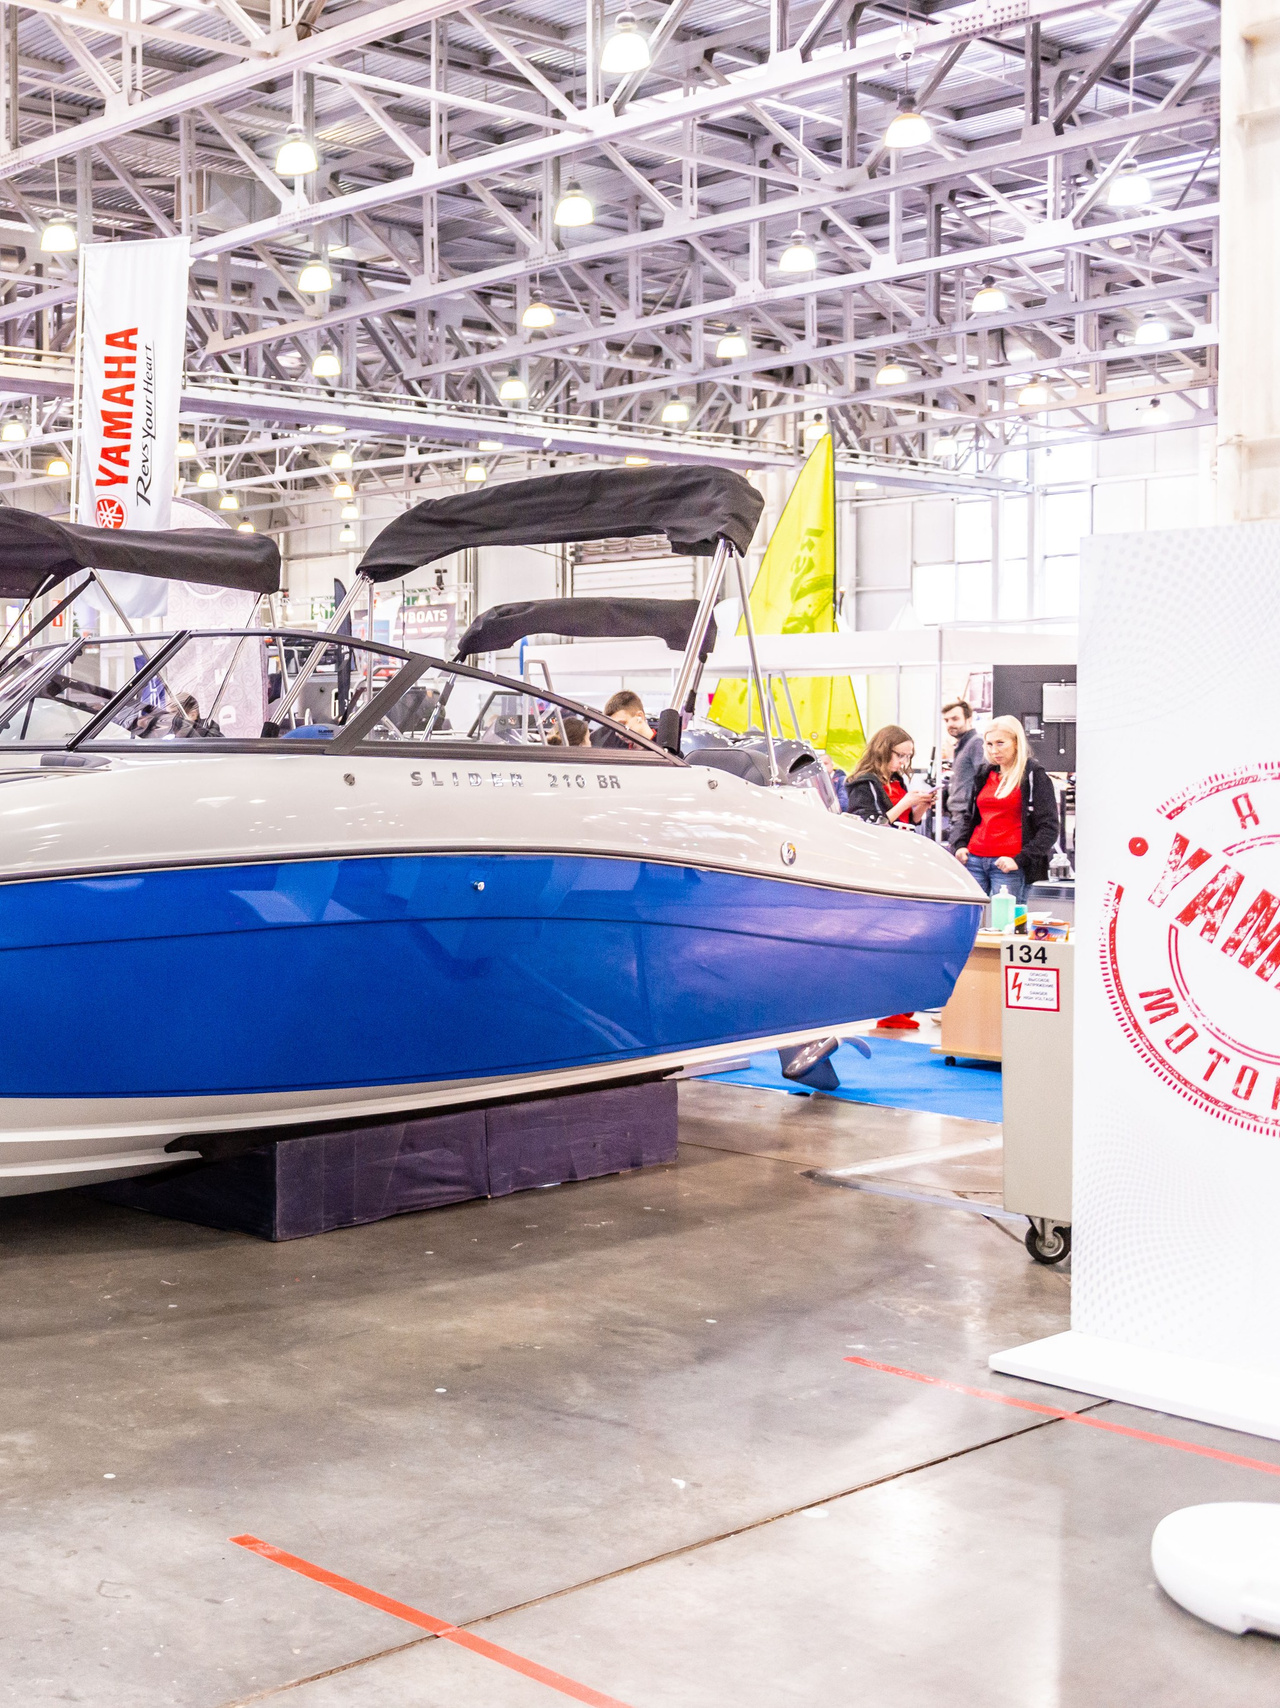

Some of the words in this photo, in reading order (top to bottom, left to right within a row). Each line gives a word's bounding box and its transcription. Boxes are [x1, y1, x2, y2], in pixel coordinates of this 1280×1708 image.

[142, 344, 154, 393] Heart
[95, 327, 139, 487] YAMAHA
[142, 394, 157, 440] Your
[136, 443, 152, 506] Revs
[410, 771, 525, 788] SLIDER
[547, 773, 587, 789] 210
[597, 774, 622, 790] BR
[1147, 832, 1280, 992] YAM
[1005, 944, 1048, 964] 134
